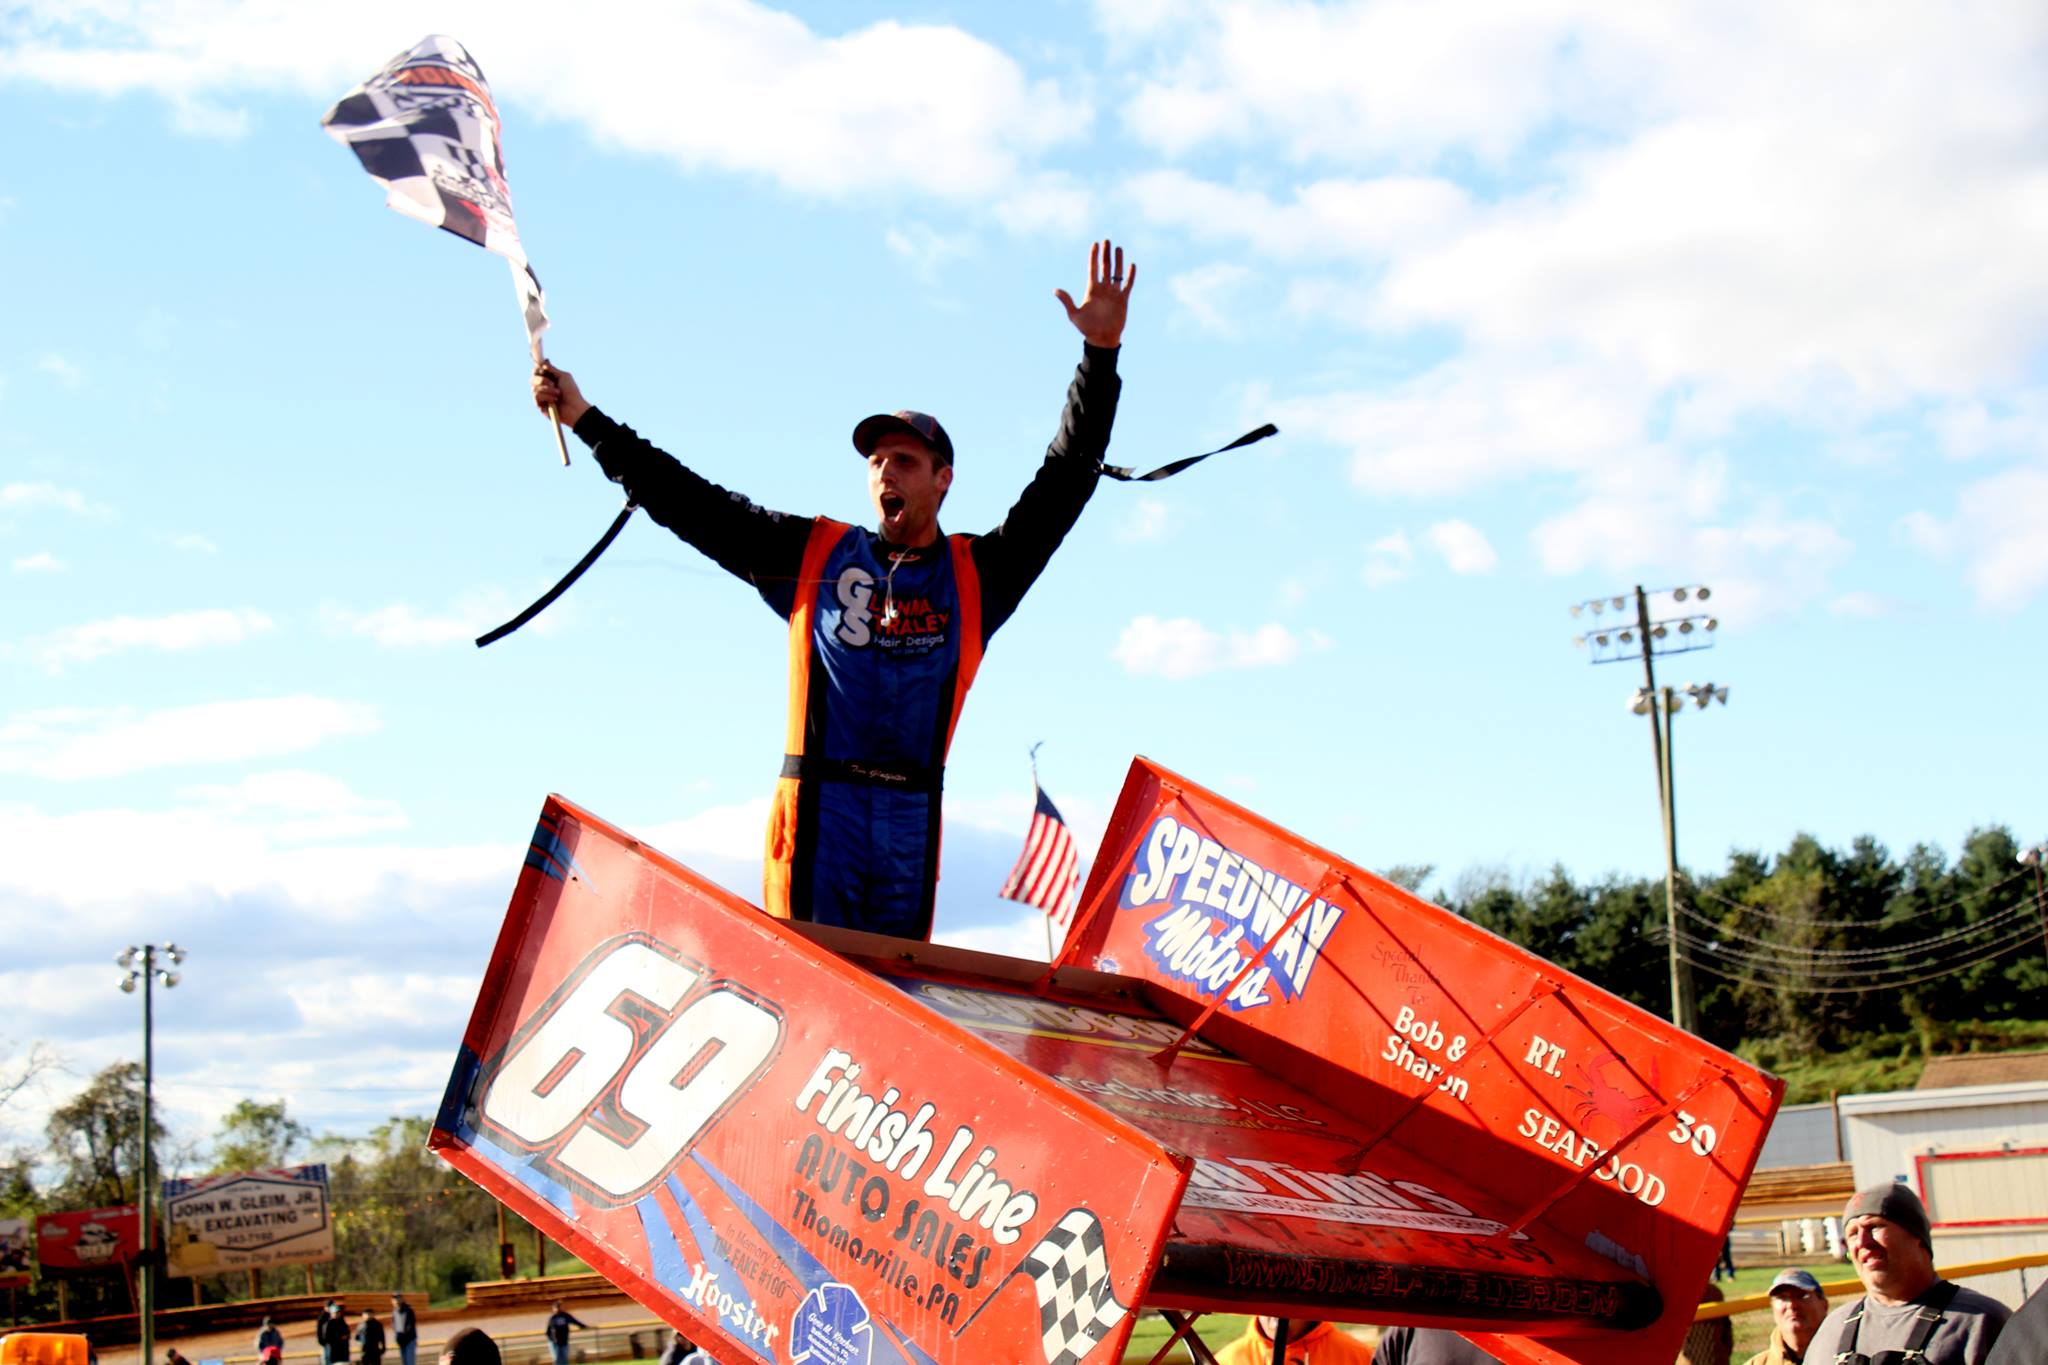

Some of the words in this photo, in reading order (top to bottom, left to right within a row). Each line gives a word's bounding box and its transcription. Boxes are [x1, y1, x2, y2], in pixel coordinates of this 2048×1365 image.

[874, 634, 901, 648] Hair
[906, 632, 945, 648] Designs
[1128, 816, 1343, 998] SPEEDWAY
[477, 938, 783, 1200] 69
[1381, 1034, 1470, 1102] Sharon
[1394, 1004, 1445, 1051] Bob
[1446, 1034, 1467, 1063] &
[1238, 1097, 1324, 1125] LLC
[1524, 1034, 1567, 1079] RT.
[1667, 1109, 1717, 1157] 30
[795, 1047, 937, 1182] Finish
[923, 1124, 1039, 1246] Line
[1517, 1108, 1667, 1207] SEAFOOD
[175, 1200, 215, 1218] JOHN
[219, 1198, 236, 1212] W.
[205, 1209, 298, 1232] EXCAVATING
[790, 1133, 891, 1223] AUTO
[893, 1199, 991, 1289] SALES
[1226, 1156, 1475, 1217] Tim's
[680, 1263, 779, 1348] Hoosier
